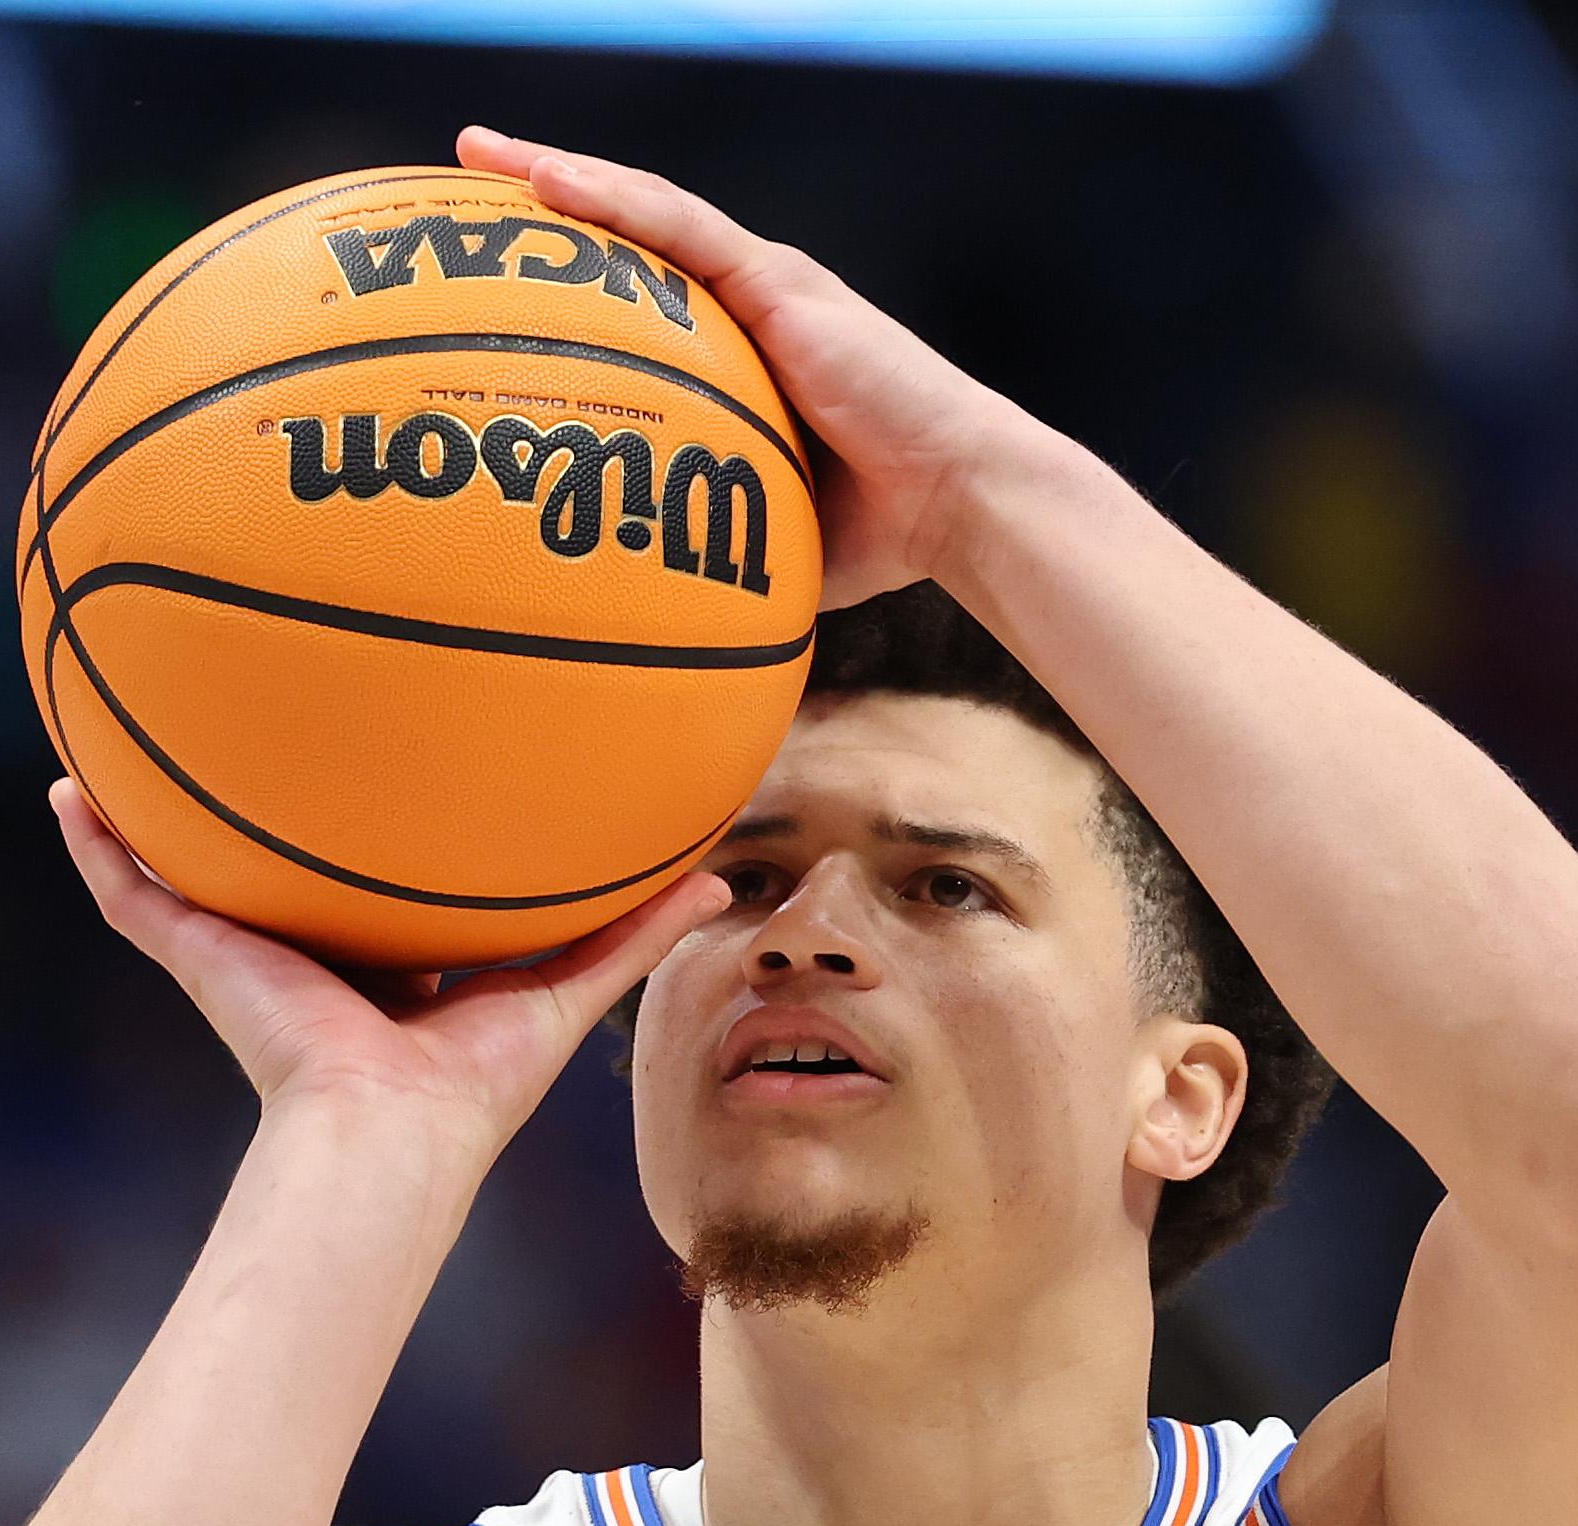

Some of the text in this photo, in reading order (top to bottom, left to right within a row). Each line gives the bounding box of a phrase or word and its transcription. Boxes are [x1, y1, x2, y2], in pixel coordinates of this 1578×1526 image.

[321, 214, 695, 332] NCAA
[419, 388, 663, 424] INDOOR GAME BALL
[276, 408, 771, 598] Wilson
